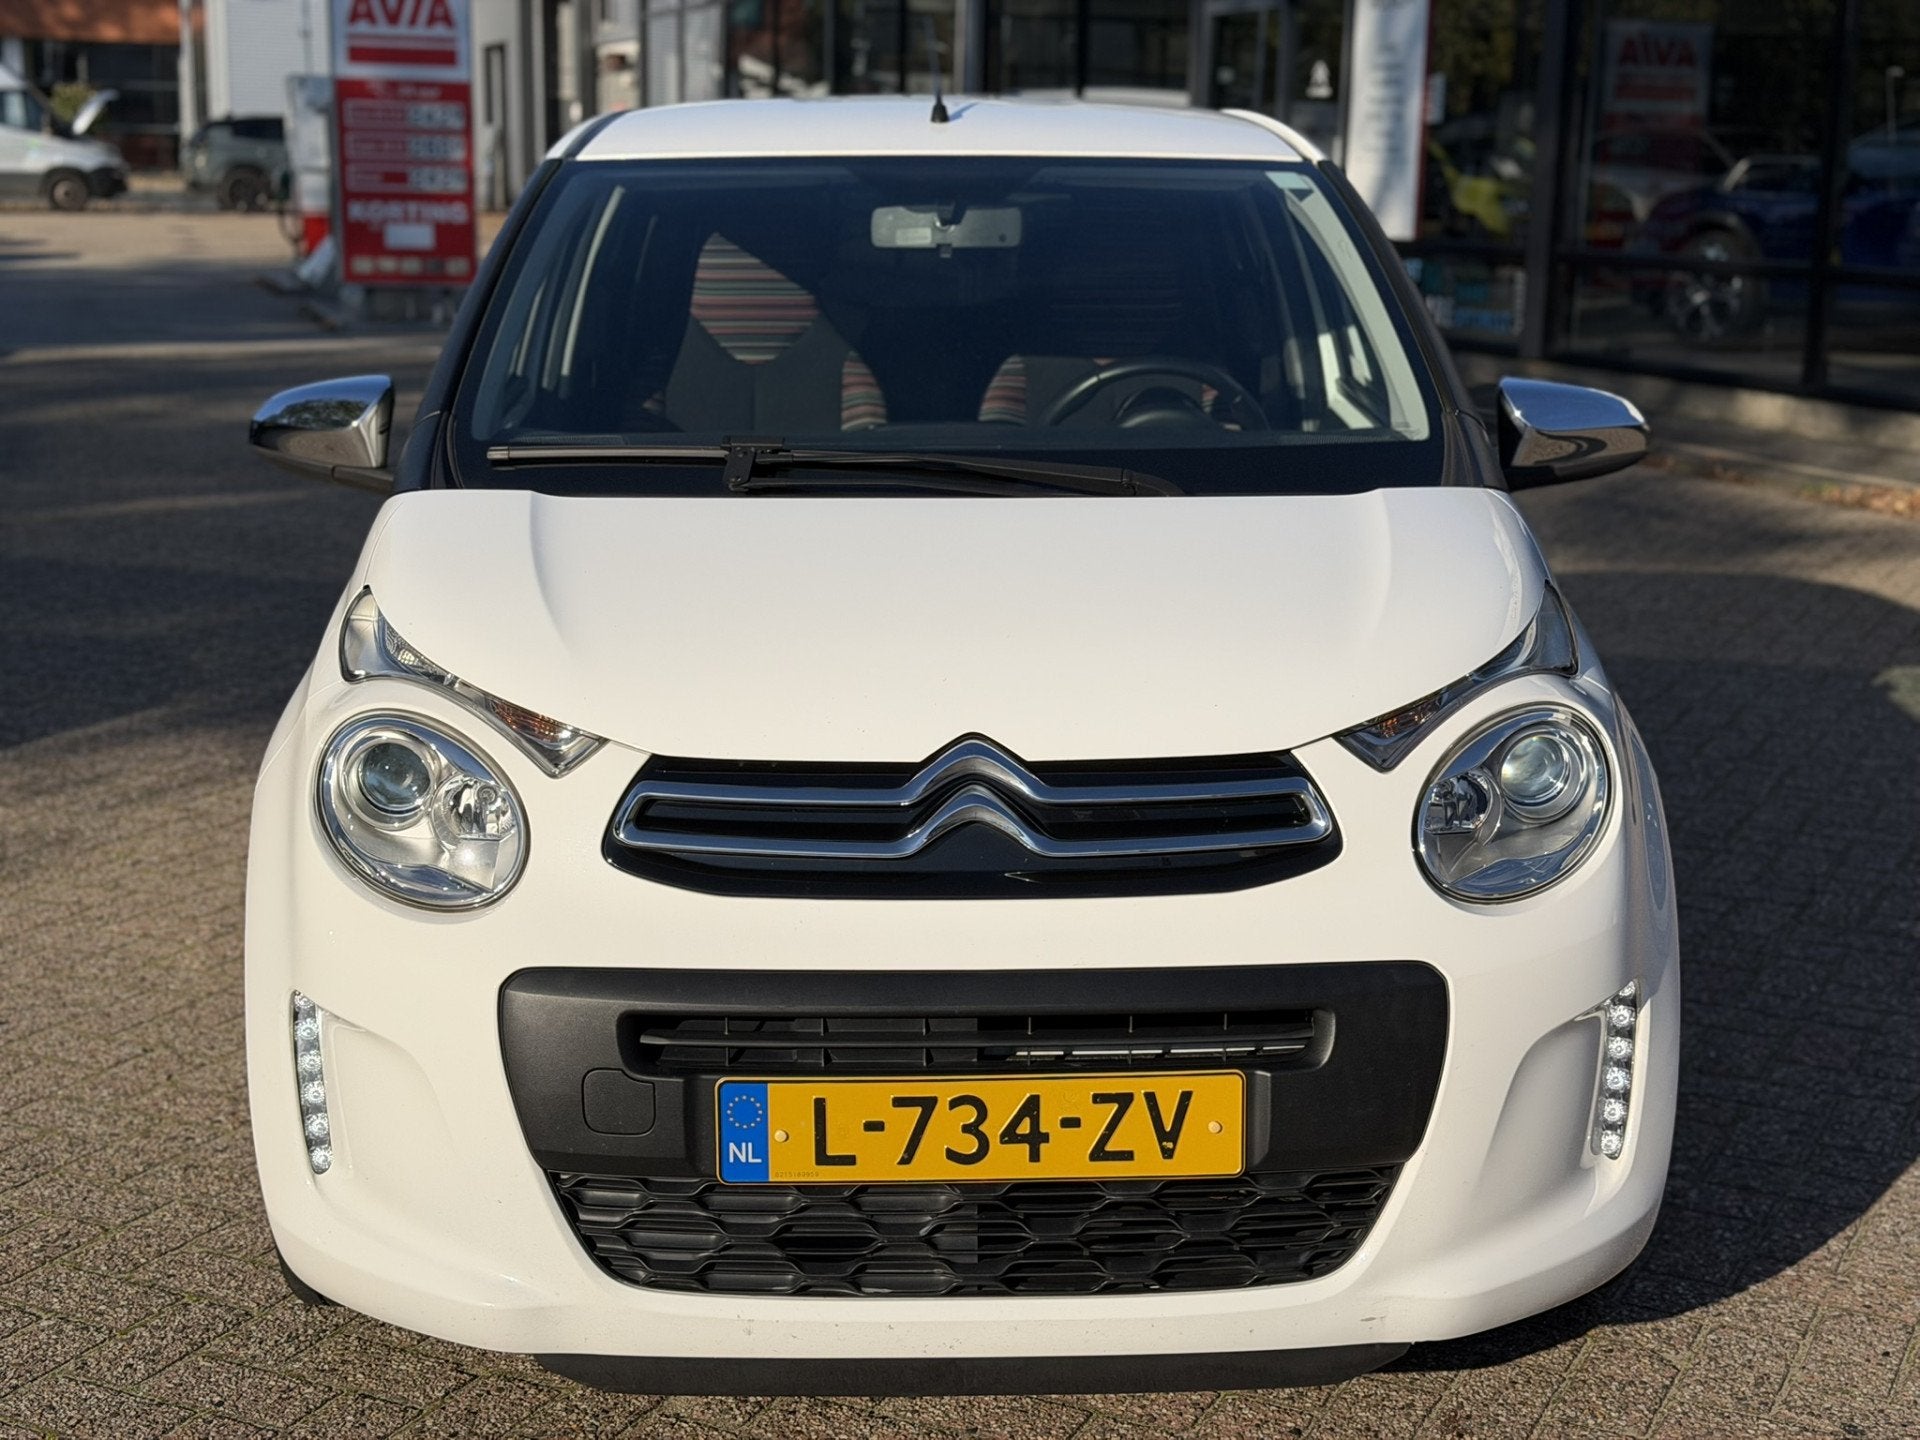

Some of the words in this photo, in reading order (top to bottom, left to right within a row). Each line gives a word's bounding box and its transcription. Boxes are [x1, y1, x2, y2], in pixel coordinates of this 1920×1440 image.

[349, 0, 455, 27] AVIA
[813, 1090, 1194, 1166] L-734-ZV
[728, 1142, 762, 1163] NL
